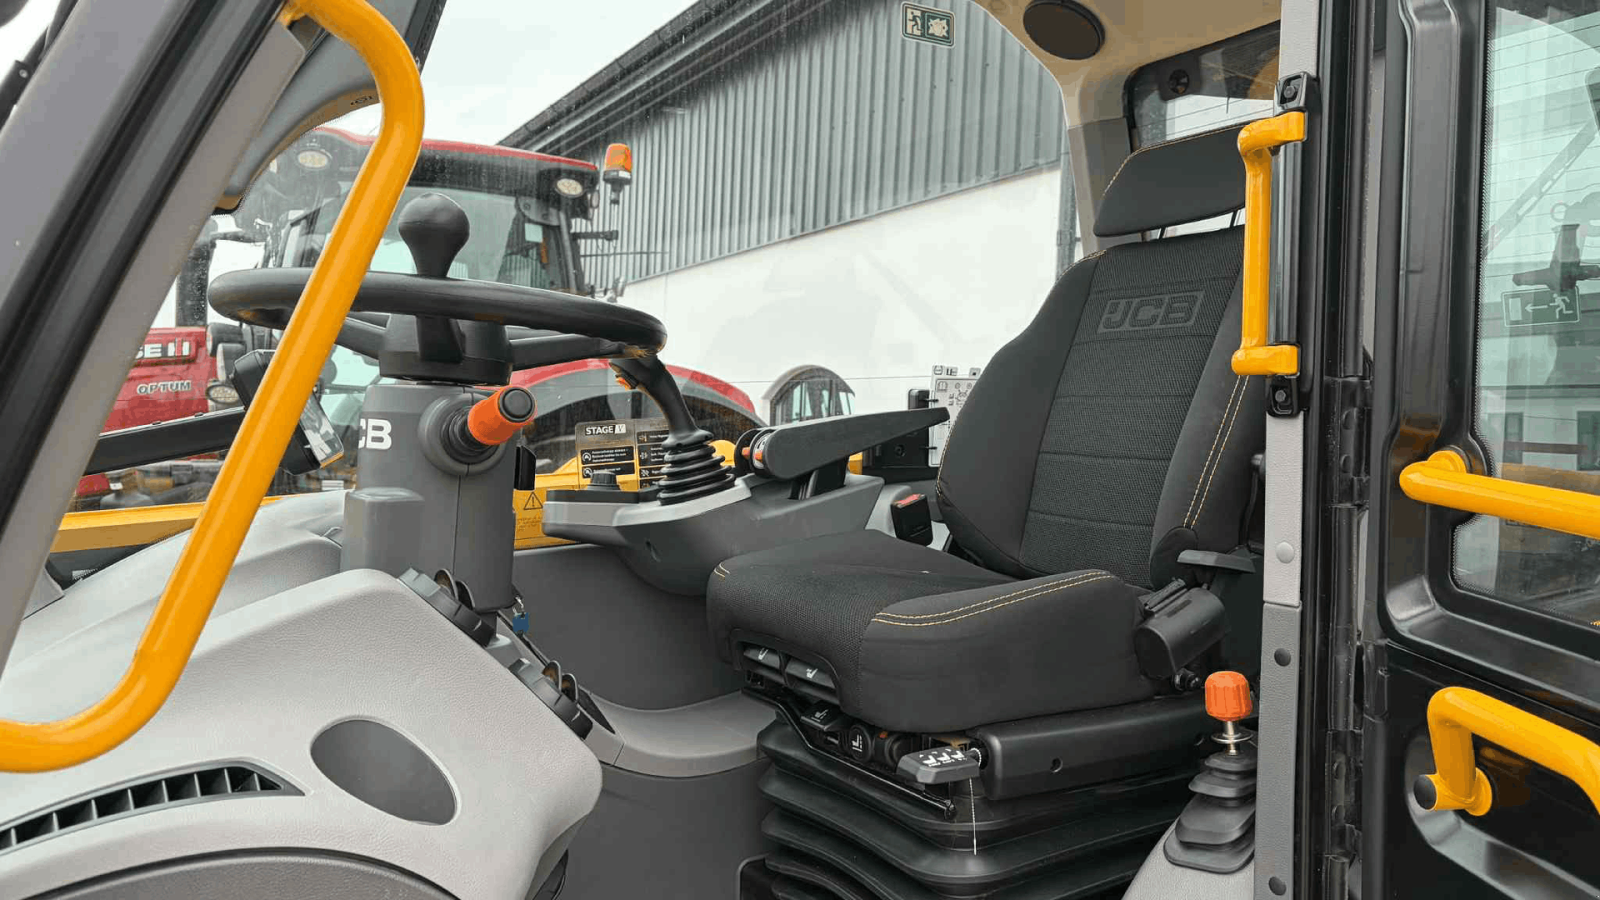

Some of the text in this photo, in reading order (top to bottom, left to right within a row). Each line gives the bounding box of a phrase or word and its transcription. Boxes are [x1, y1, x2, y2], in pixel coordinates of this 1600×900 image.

[1101, 293, 1201, 331] JCB
[136, 380, 192, 395] OPTUM
[585, 425, 614, 435] STAGE
